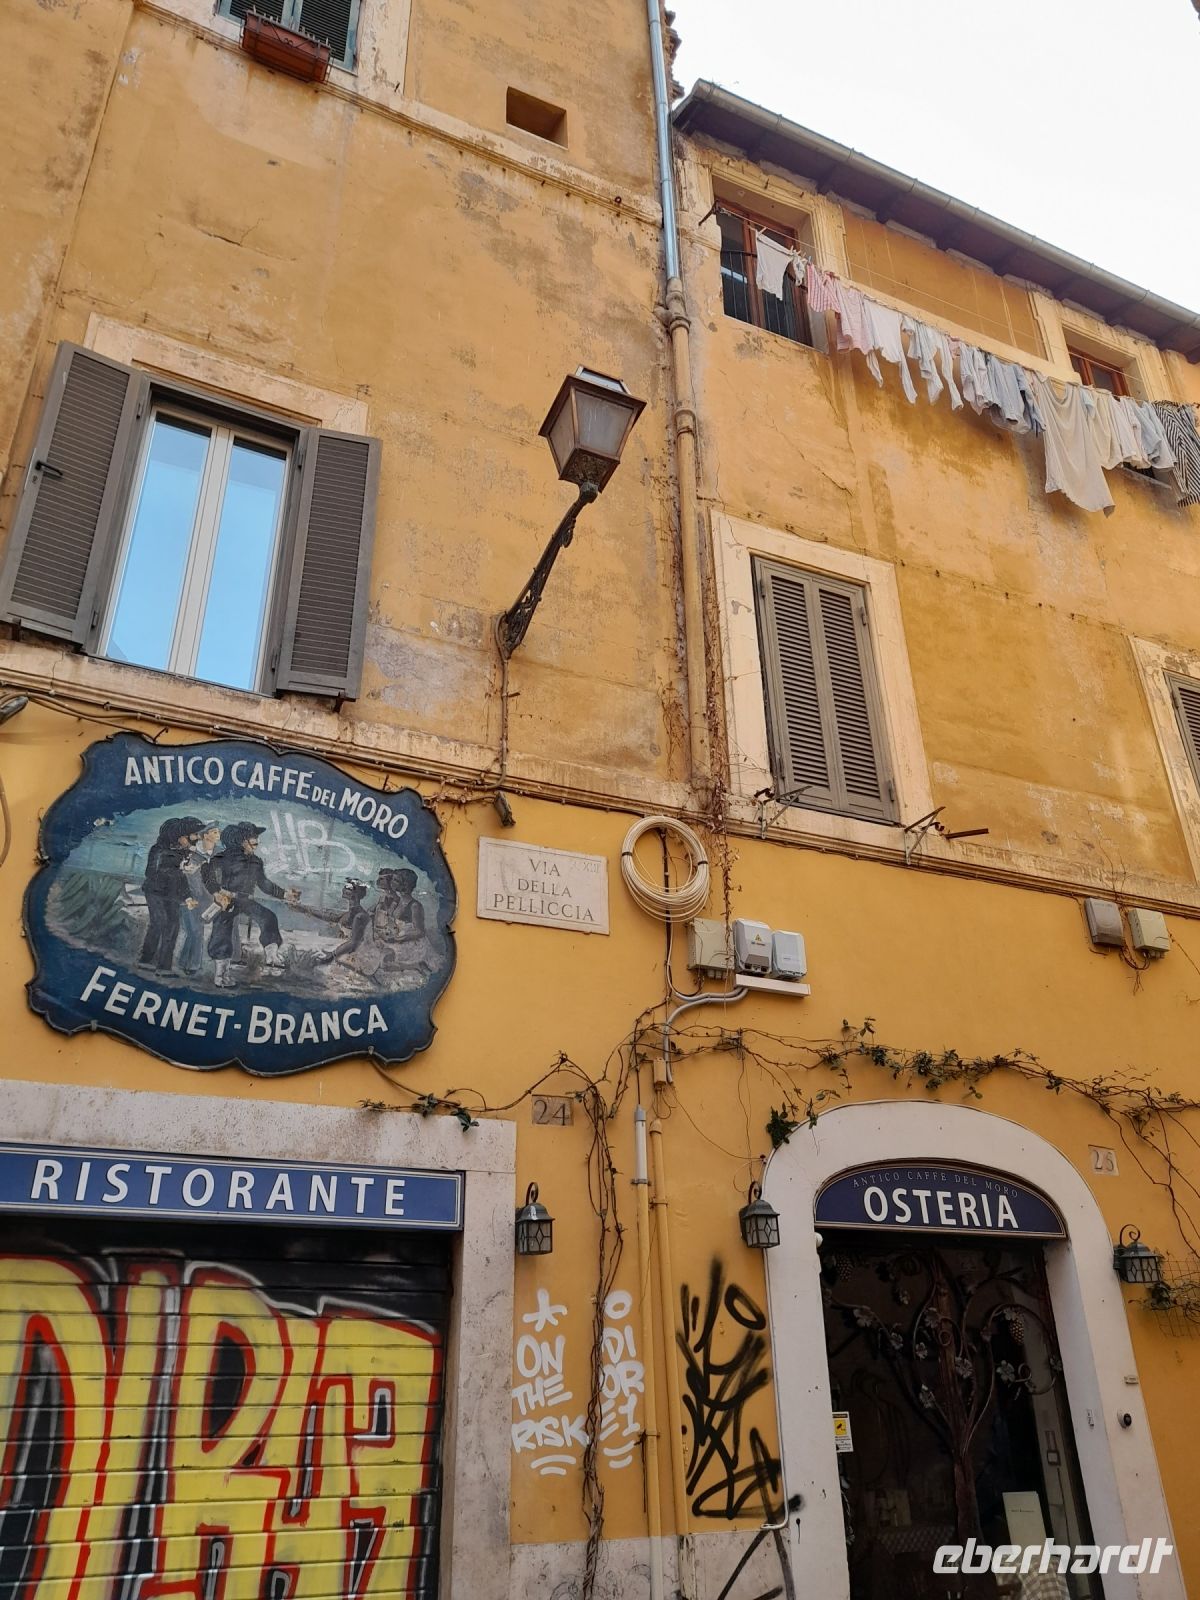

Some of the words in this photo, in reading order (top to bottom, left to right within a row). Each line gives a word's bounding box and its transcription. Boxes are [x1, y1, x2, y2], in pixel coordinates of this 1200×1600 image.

[124, 755, 225, 786] ANTICO
[311, 786, 336, 809] DEL
[338, 787, 409, 839] MORO
[528, 857, 561, 876] VIA
[493, 893, 595, 921] PELLICCIA
[517, 878, 572, 898] DELLA
[534, 1099, 570, 1126] 24
[30, 1159, 406, 1216] RISTORANTE
[852, 1171, 901, 1188] ANTICO
[954, 1174, 977, 1186] DEL
[985, 1180, 1019, 1198] MORO
[863, 1186, 1019, 1229] OSTERIA
[516, 1335, 565, 1377] ON
[512, 1374, 573, 1415] THE
[511, 1415, 590, 1453] RISK
